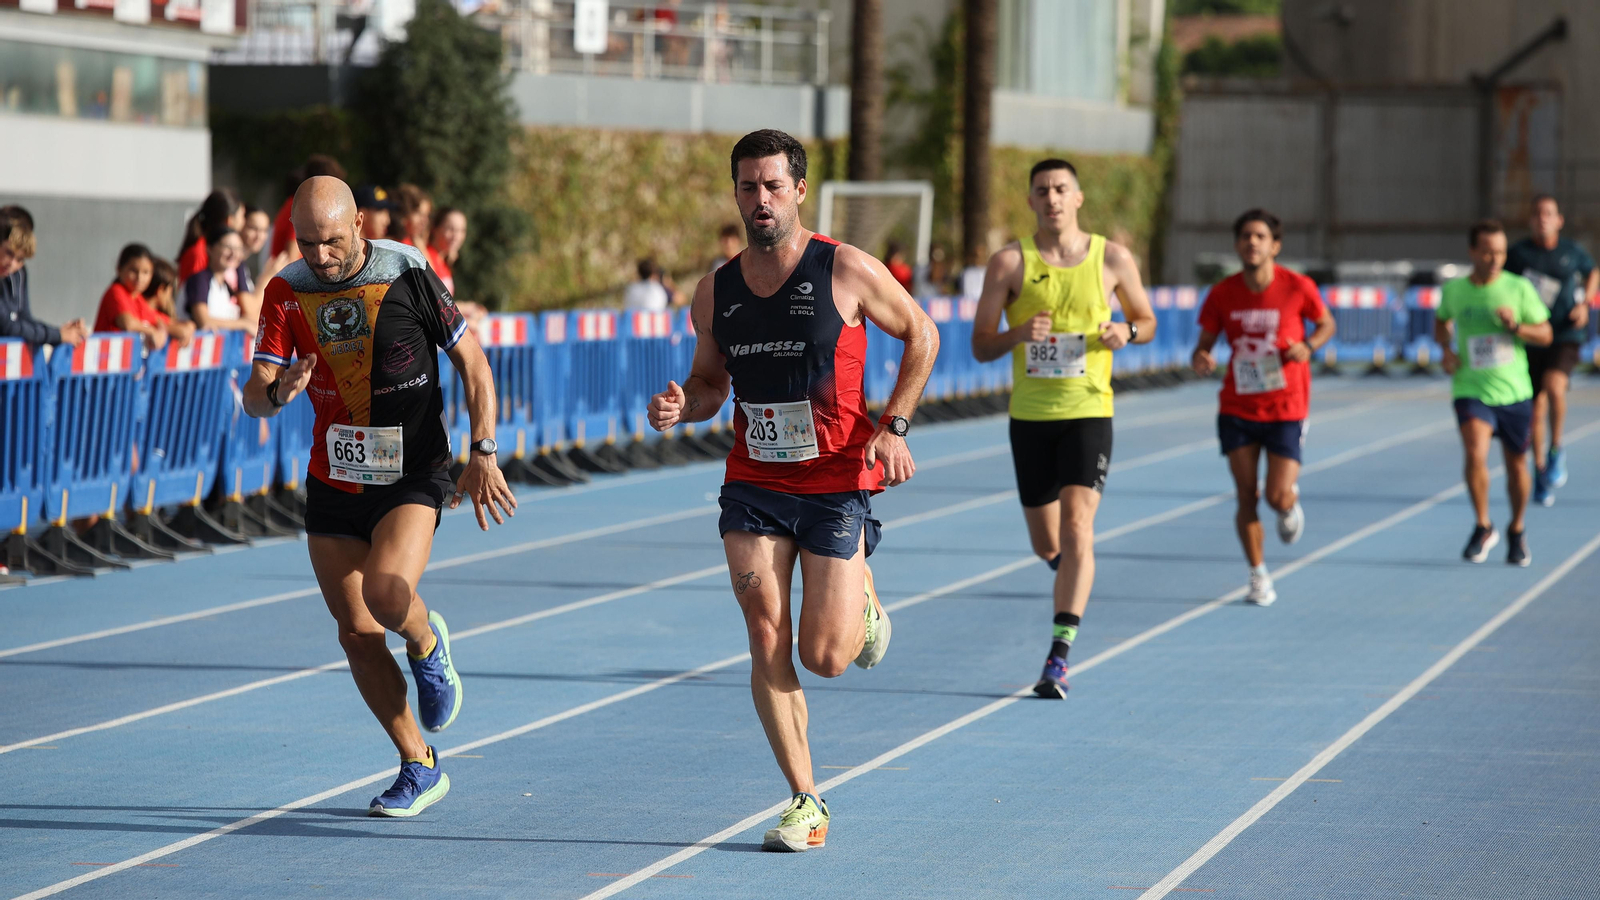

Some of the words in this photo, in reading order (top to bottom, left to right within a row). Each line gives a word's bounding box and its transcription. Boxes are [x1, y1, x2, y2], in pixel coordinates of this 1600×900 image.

[331, 340, 364, 355] JEREZ
[729, 340, 806, 358] Vanessa
[1030, 345, 1058, 361] 982
[750, 418, 778, 442] 203
[334, 440, 366, 464] 663
